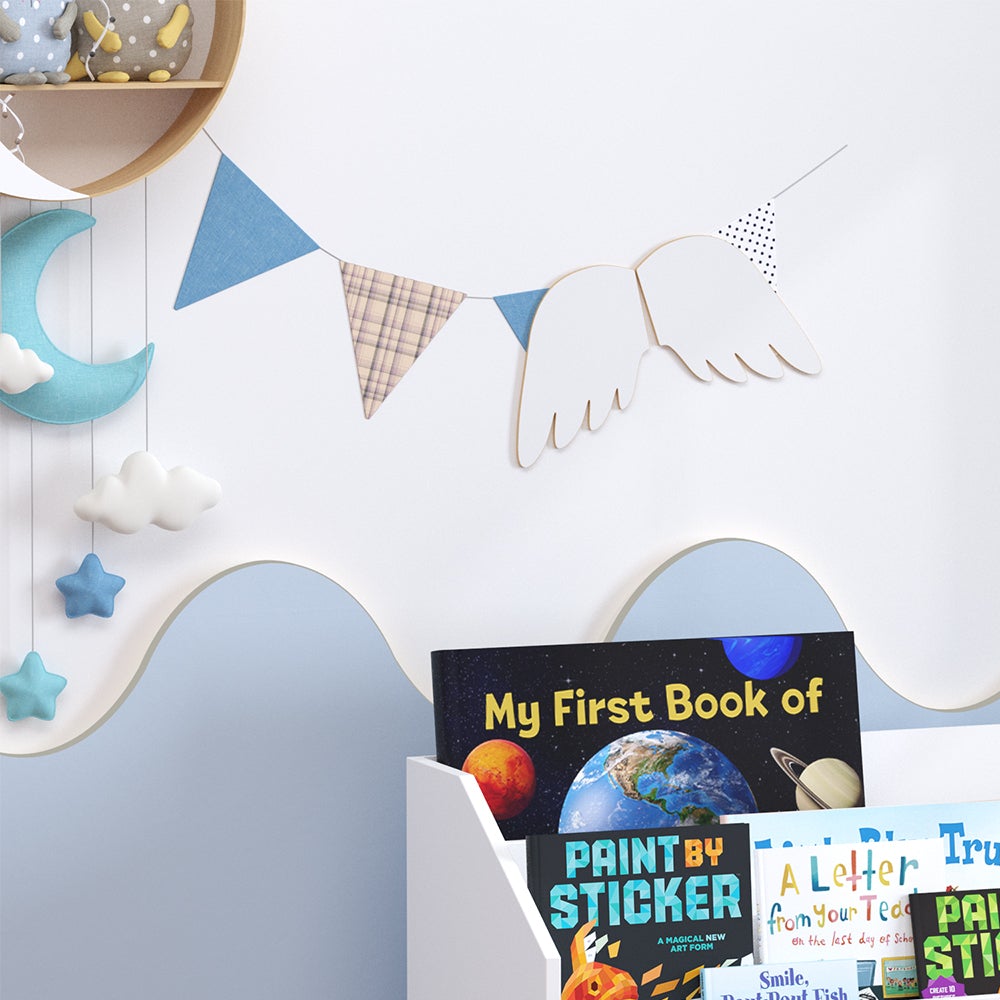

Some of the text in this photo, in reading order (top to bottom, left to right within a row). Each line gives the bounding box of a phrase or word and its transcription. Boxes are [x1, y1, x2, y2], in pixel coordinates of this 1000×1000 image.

[484, 677, 824, 738] My First Book of
[565, 835, 723, 879] PAINT BY
[780, 849, 919, 897] A Letter
[550, 873, 742, 930] STICKER
[767, 902, 811, 935] from
[813, 903, 857, 928] your
[859, 888, 918, 921] Teac
[657, 933, 726, 945] A MAGICAL NEW
[670, 943, 714, 953] ART FORM
[792, 938, 805, 946] on
[808, 935, 826, 946] the
[831, 931, 852, 947] last
[858, 932, 875, 948] day
[879, 935, 891, 946] of
[759, 967, 809, 990] Smile,
